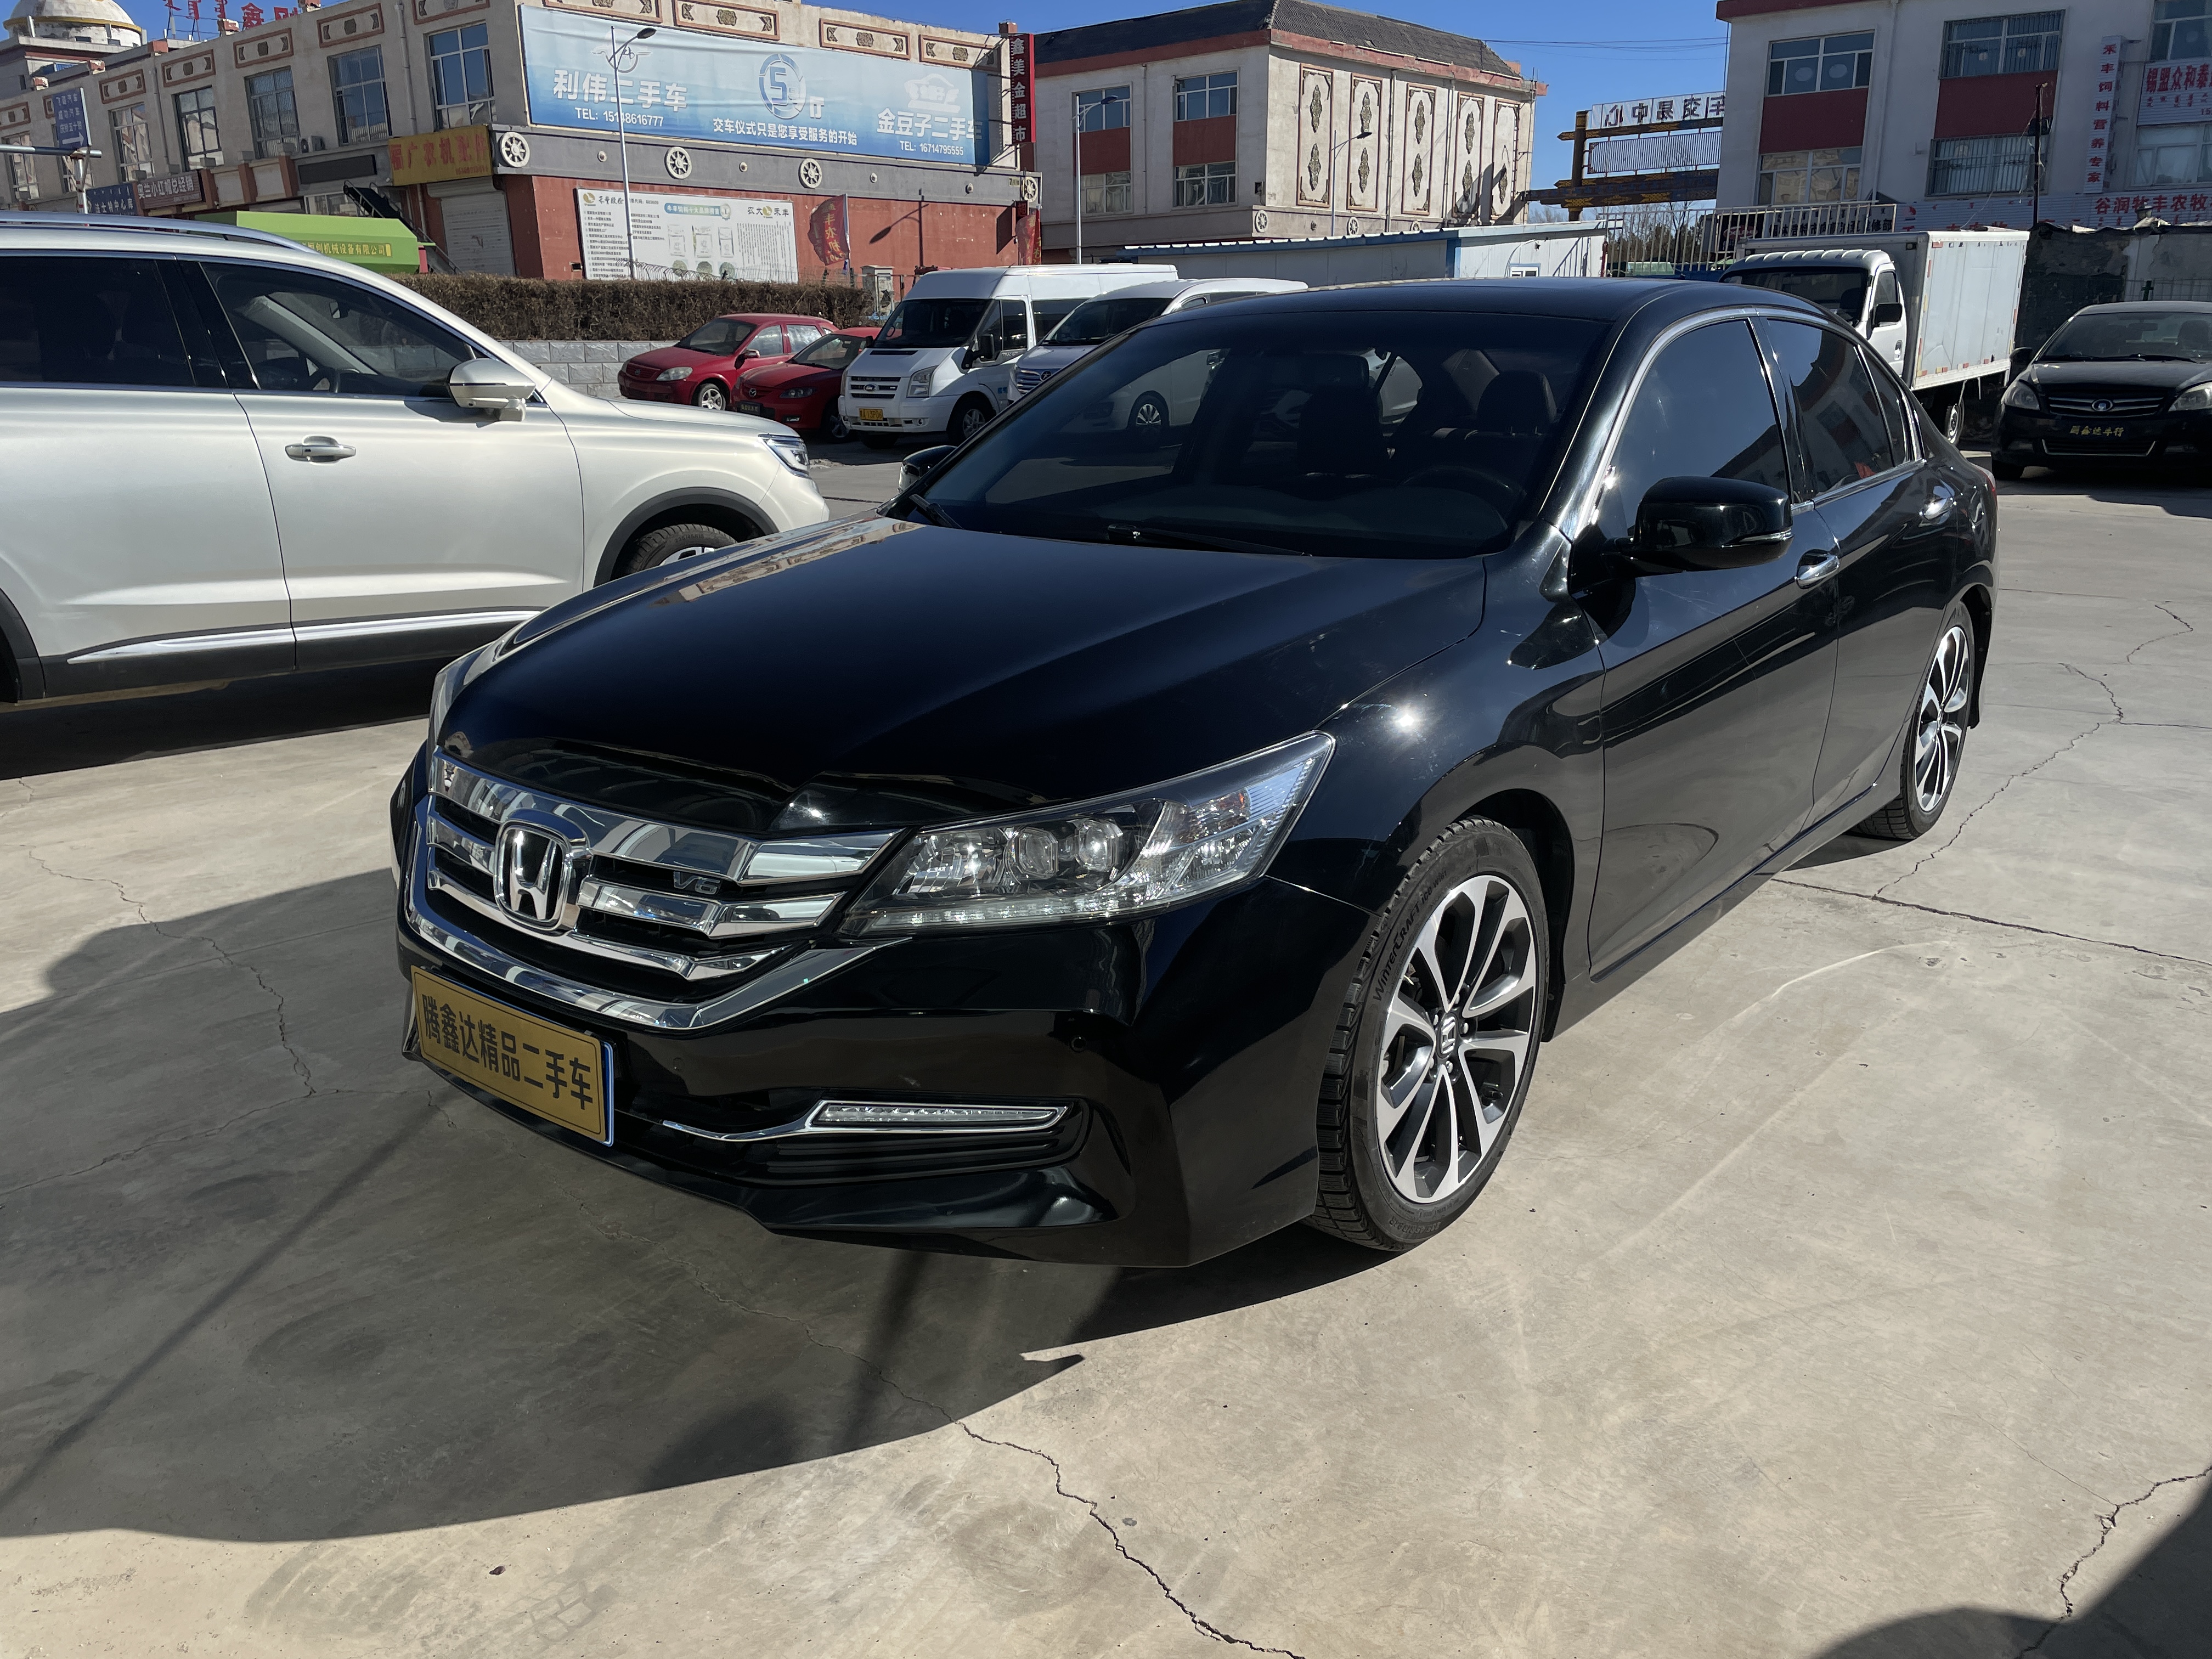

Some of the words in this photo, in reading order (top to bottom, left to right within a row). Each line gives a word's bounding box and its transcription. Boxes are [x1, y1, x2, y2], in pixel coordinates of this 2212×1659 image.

[553, 69, 687, 112] 利伟二手车
[1012, 37, 1026, 142] 鑫美金超市
[877, 108, 983, 142] 金豆子二手车
[2087, 44, 2117, 183] 禾丰饲料营养专家
[713, 117, 858, 146] 交车仪式只是您享受服务的开始
[919, 143, 964, 156] 16714795555
[2095, 193, 2212, 215] 谷润牧丰农牧
[673, 871, 720, 895] V6
[422, 994, 593, 1110] 腾鑫达精品二手车
